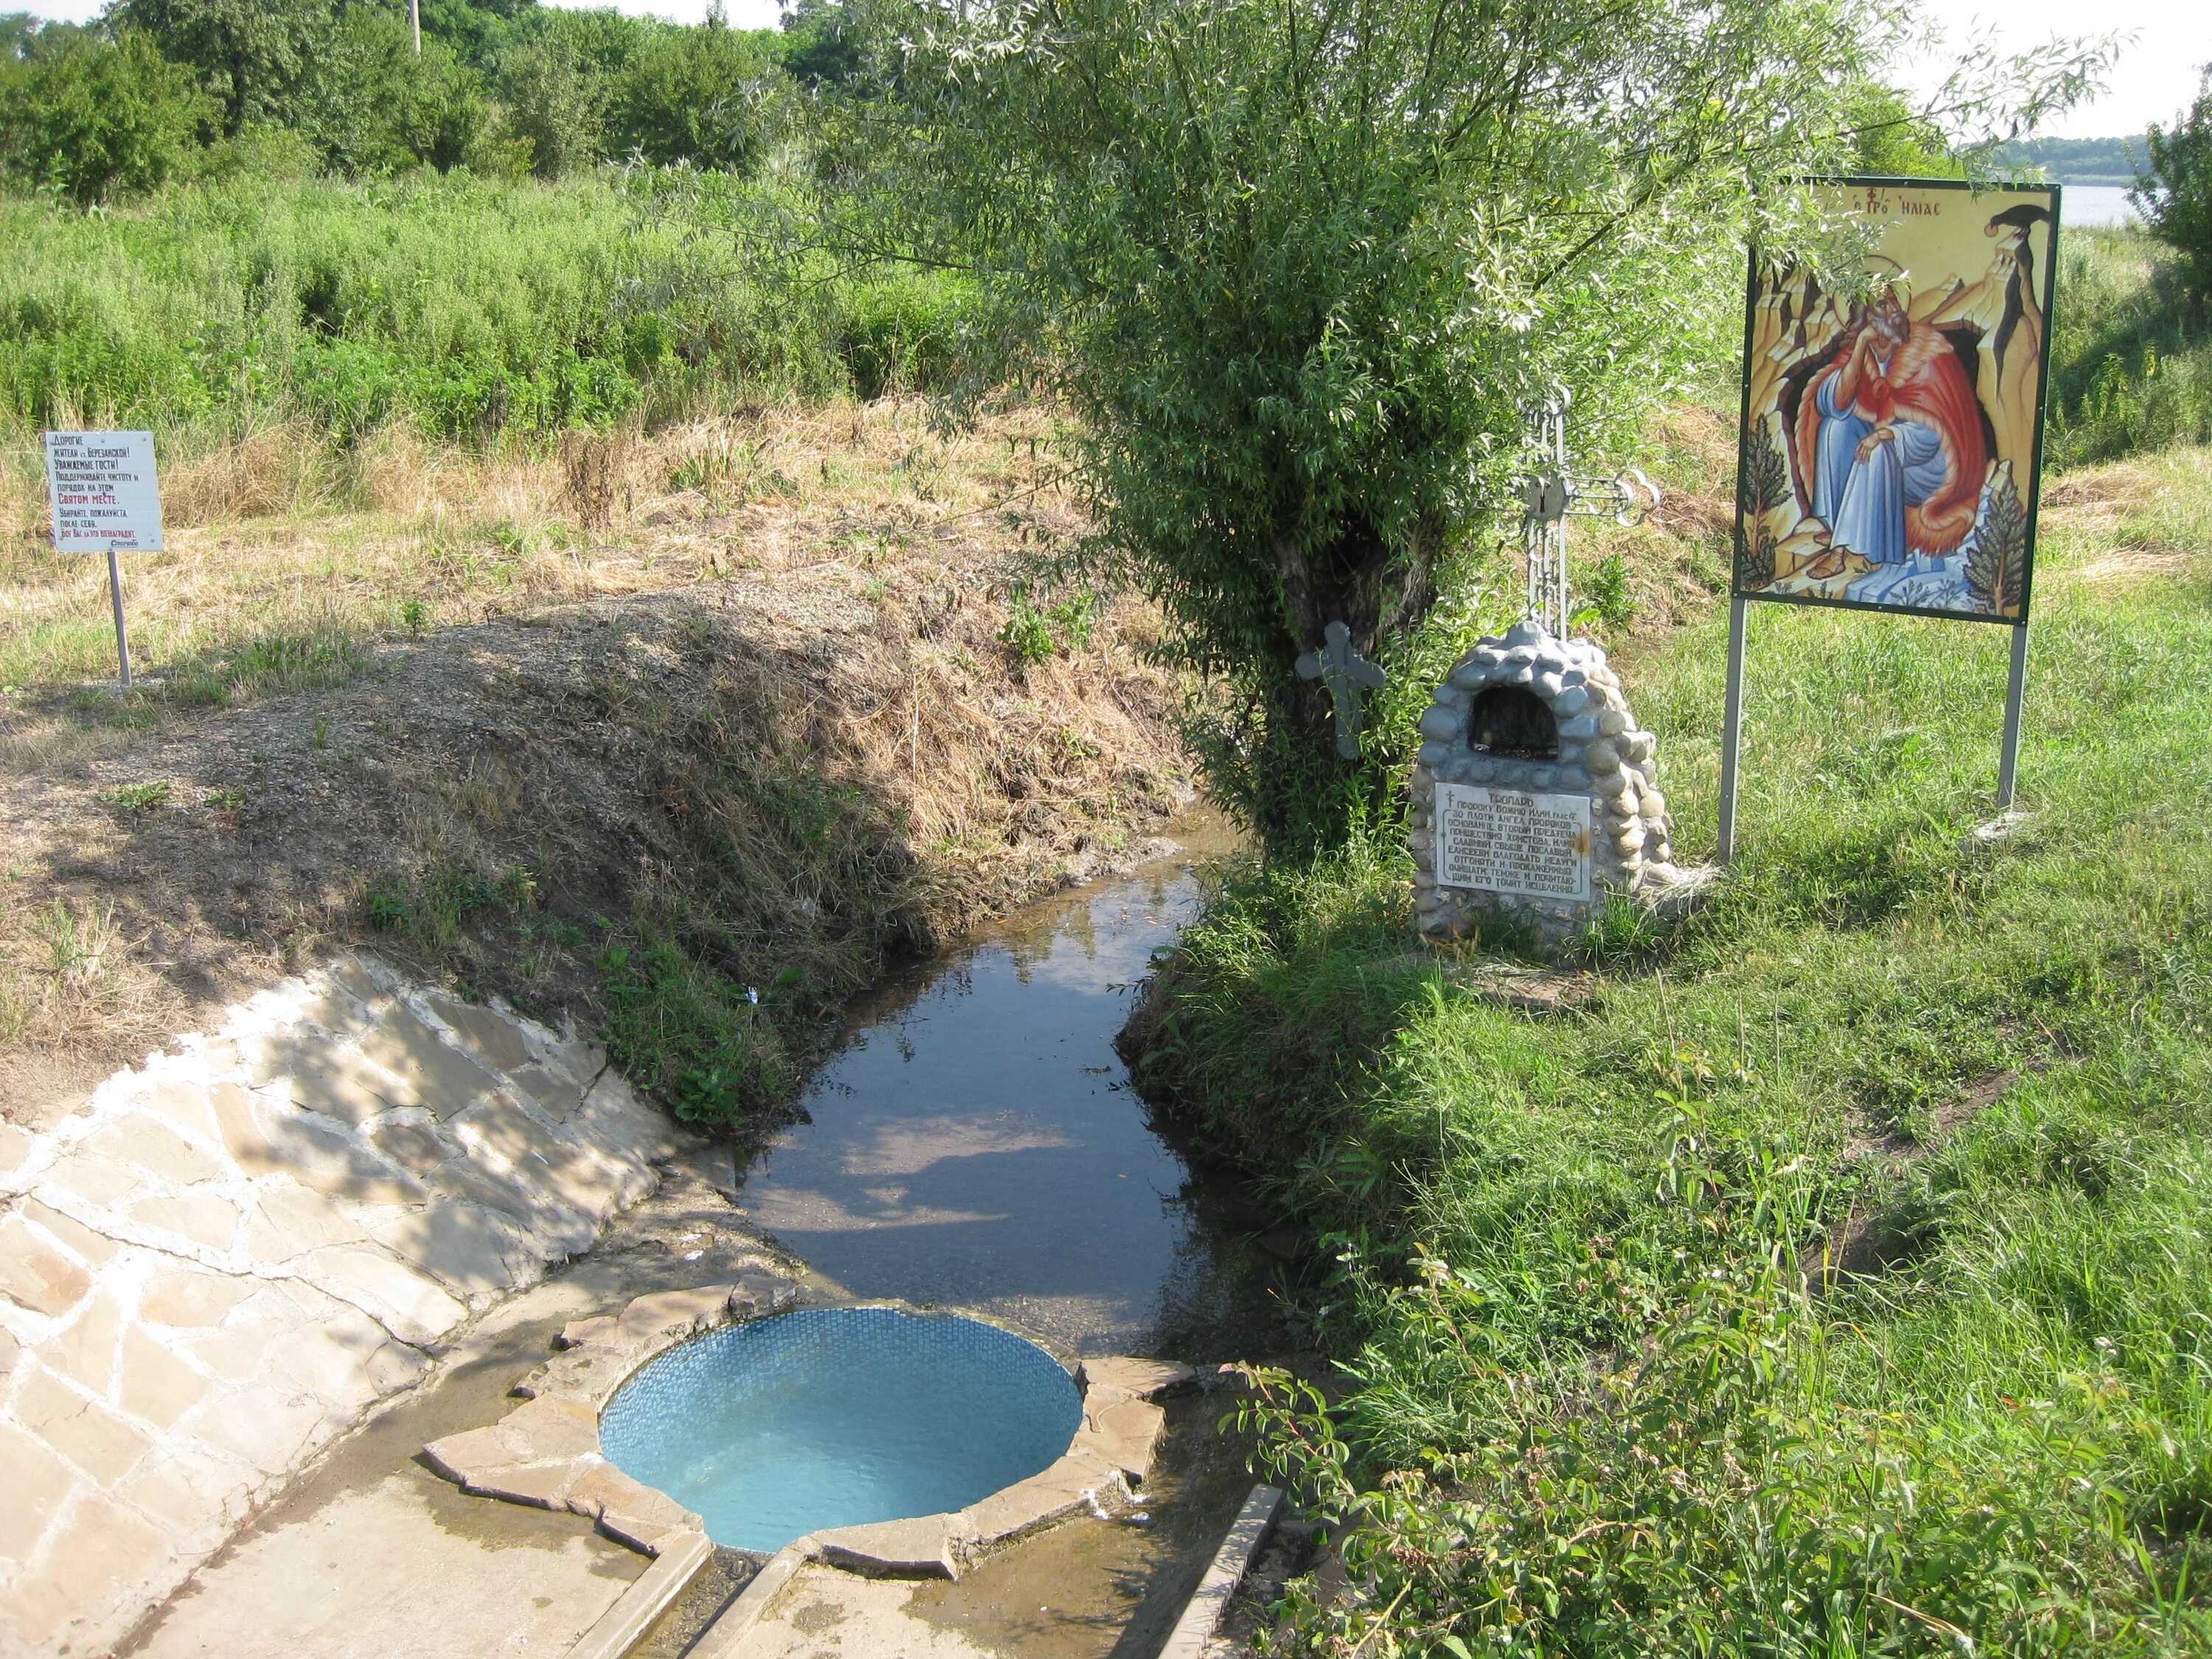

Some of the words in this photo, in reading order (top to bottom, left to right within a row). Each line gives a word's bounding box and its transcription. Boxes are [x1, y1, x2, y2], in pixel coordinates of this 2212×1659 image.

[1489, 794, 1534, 806] ТРОПАРЬ
[1457, 801, 1493, 813] ПРОРОКУ
[1475, 875, 1492, 884] ЕГО
[1524, 872, 1531, 880] И
